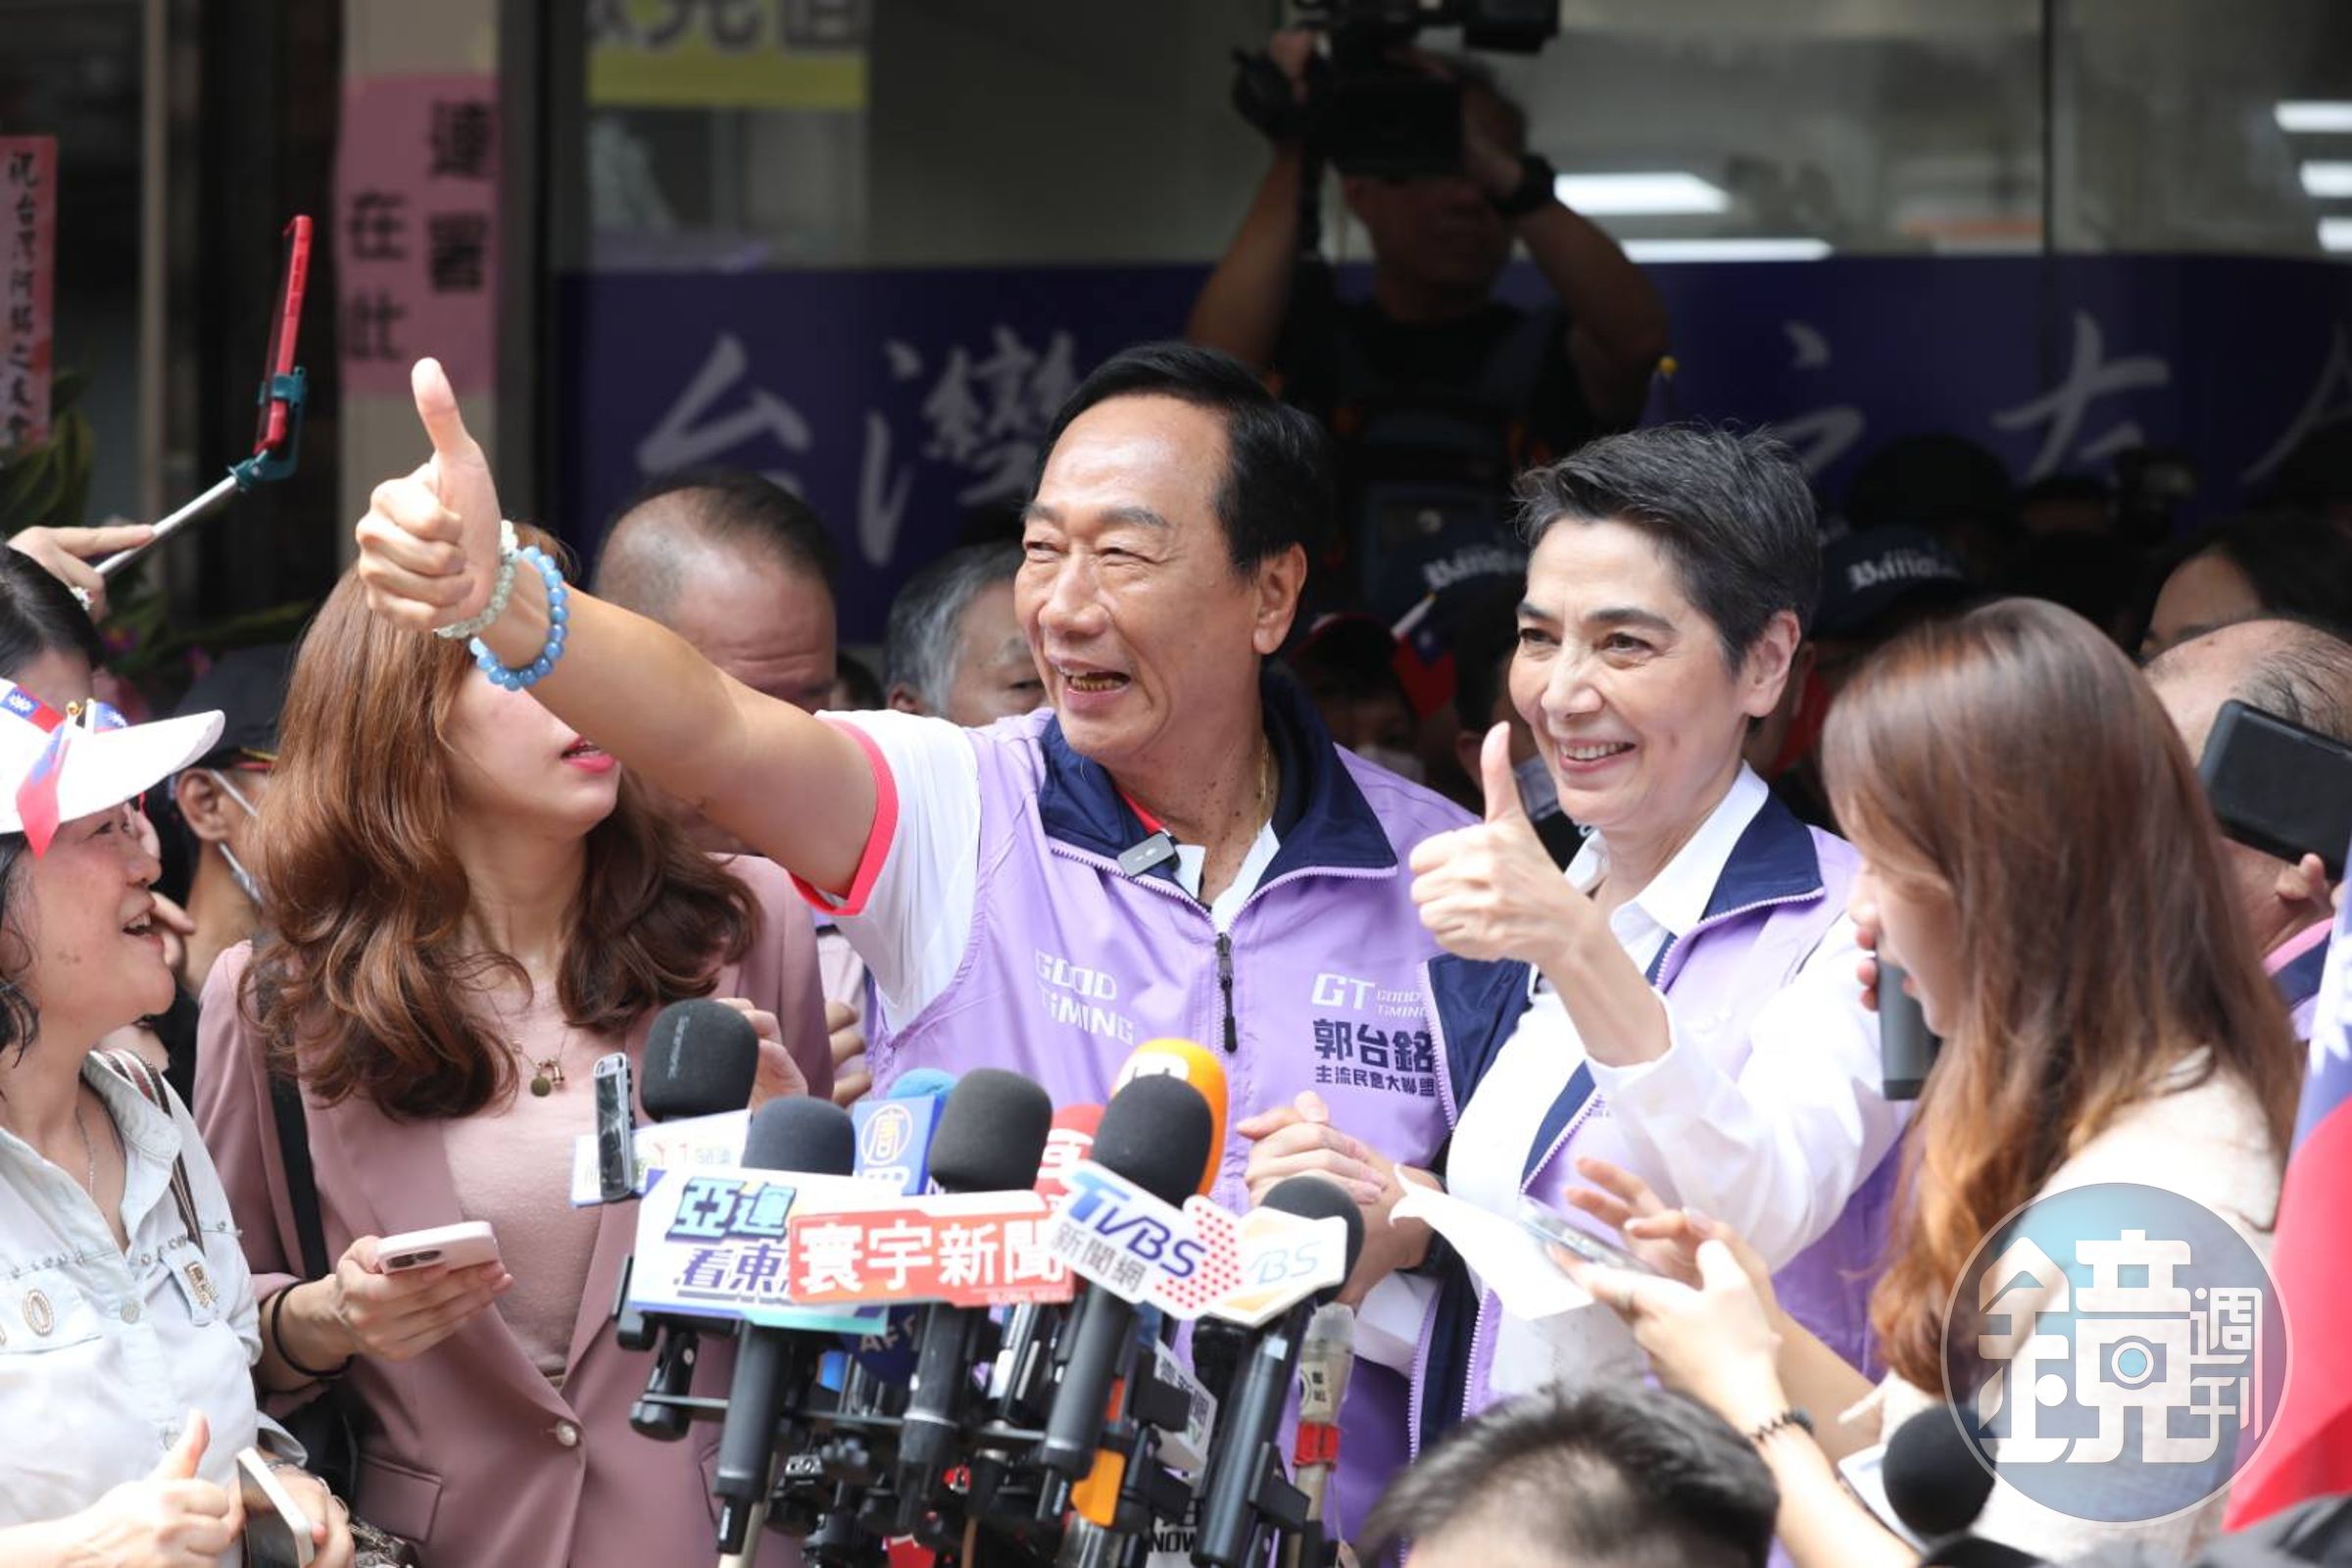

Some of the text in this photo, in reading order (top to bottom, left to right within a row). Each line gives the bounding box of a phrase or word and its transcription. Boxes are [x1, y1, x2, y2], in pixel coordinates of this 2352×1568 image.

[1311, 972, 1375, 1010] GT
[1312, 1018, 1434, 1074] 郭台銘
[1315, 1064, 1436, 1098] 主流民意大聯盟
[1069, 1169, 1206, 1278] TVBS
[673, 1244, 790, 1303] 看東
[798, 1217, 1065, 1295] 寰宇新聞
[1056, 1221, 1148, 1294] 新聞網
[1249, 1241, 1322, 1286] VBS
